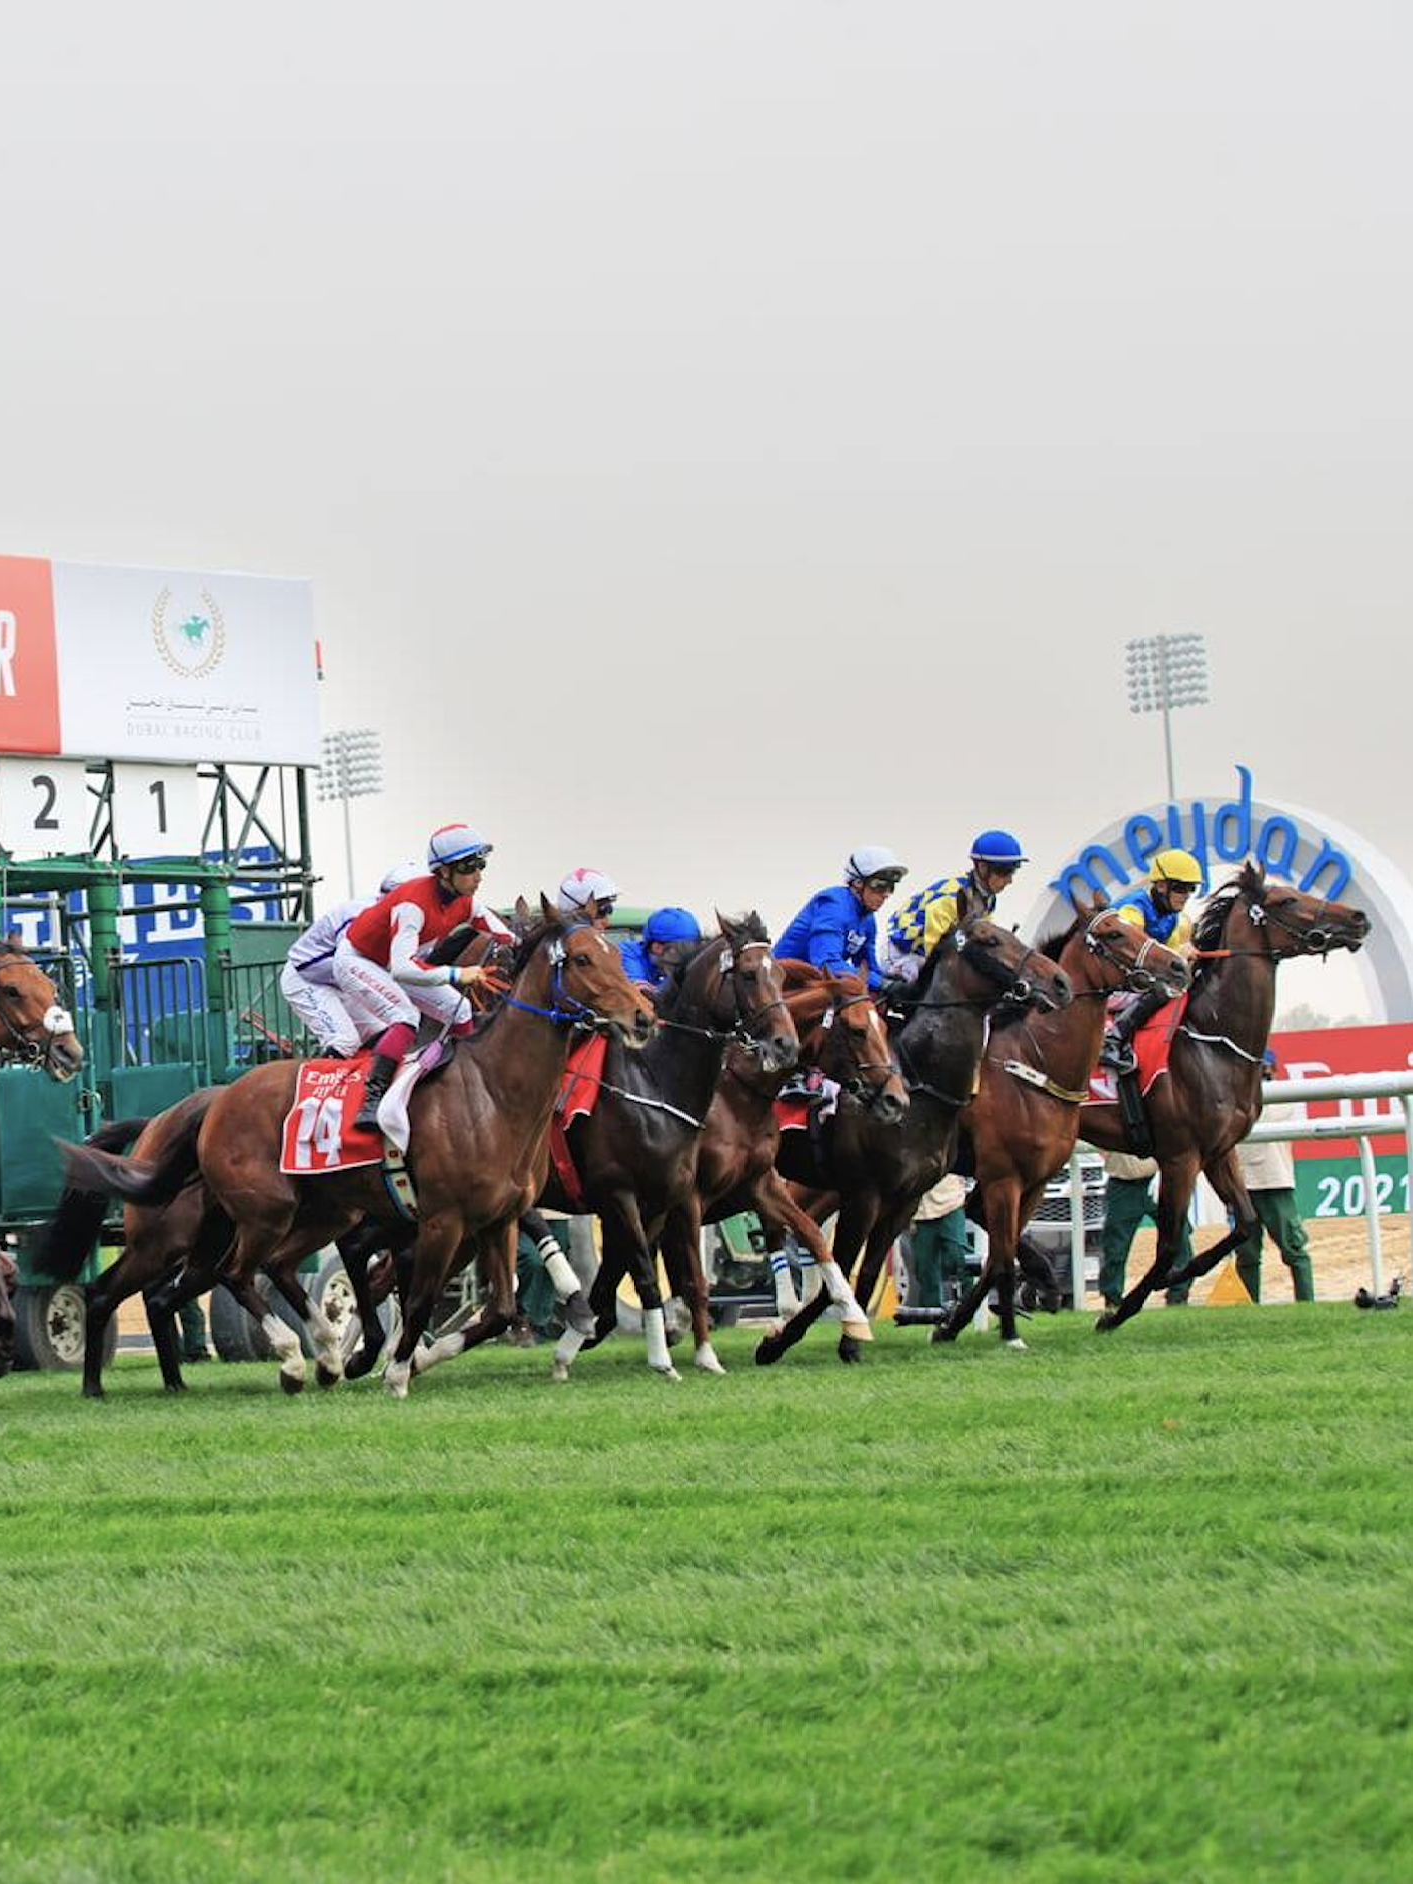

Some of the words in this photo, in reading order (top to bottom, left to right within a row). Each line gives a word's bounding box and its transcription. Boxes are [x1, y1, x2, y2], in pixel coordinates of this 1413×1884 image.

[32, 775, 59, 830] 2
[149, 780, 166, 833] 1
[1050, 765, 1352, 903] meydan
[295, 1097, 344, 1168] 14
[1315, 1173, 1410, 1217] 2021
